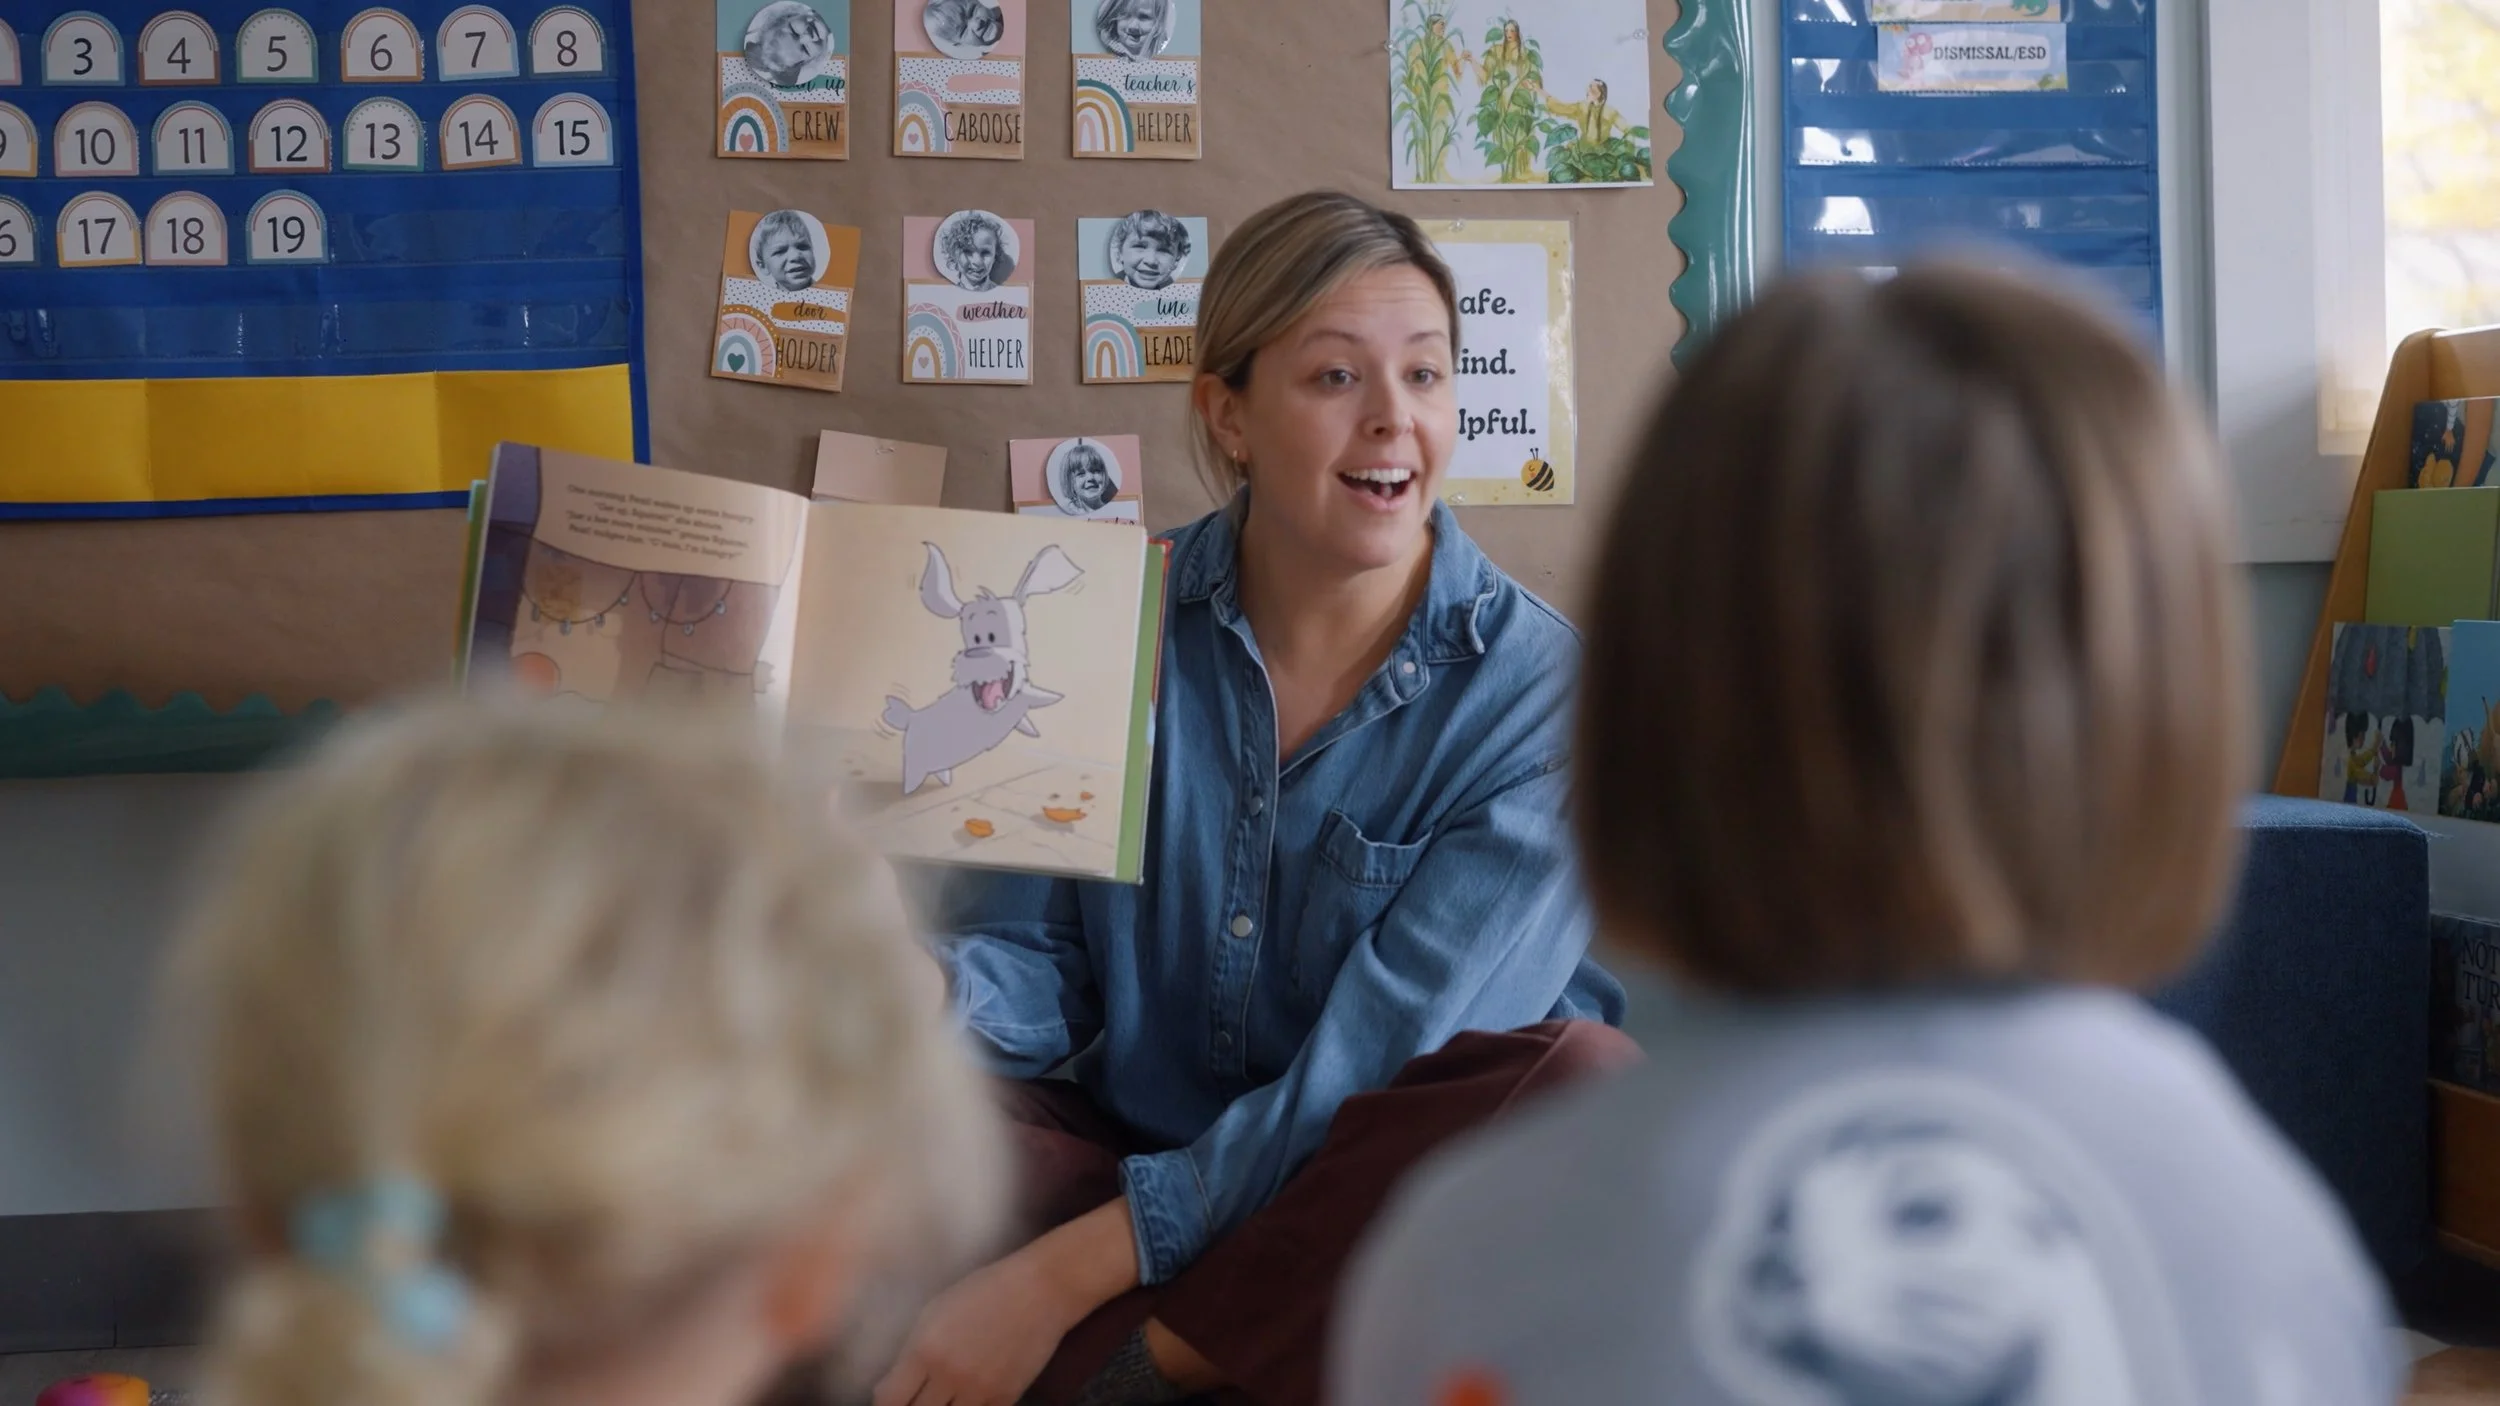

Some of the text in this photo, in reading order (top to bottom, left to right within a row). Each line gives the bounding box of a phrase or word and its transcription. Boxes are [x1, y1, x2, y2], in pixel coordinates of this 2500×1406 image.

[73, 37, 93, 75] 3
[166, 37, 191, 74] 4
[266, 35, 288, 72] 5
[370, 33, 393, 71] 6
[465, 31, 486, 68] 7
[557, 30, 578, 67] 8
[1933, 46, 2047, 61] DISMISSAL/ESD
[825, 78, 845, 96] up
[1123, 73, 1196, 94] teacher's
[270, 125, 308, 163] 12
[365, 122, 401, 160] 13
[459, 119, 499, 157] 14
[554, 119, 591, 156] 15
[792, 110, 840, 141] CREW
[943, 111, 1022, 144] CABOOSE
[1137, 112, 1192, 143] HELPER
[74, 128, 116, 165] 10
[178, 127, 207, 165] 11
[0, 219, 17, 257] 6
[78, 217, 116, 255] 17
[166, 217, 205, 255] 18
[267, 215, 306, 254] 19
[793, 300, 827, 320] door
[962, 301, 1027, 320] weather
[1157, 297, 1190, 316] line
[1458, 288, 1516, 315] afe.
[775, 336, 837, 375] HOLDER
[968, 338, 1025, 369] HELPER
[1144, 335, 1194, 366] LEADE
[1454, 348, 1516, 375] ind.
[1458, 408, 1536, 441] lpful.
[2463, 970, 2500, 1010] TUR
